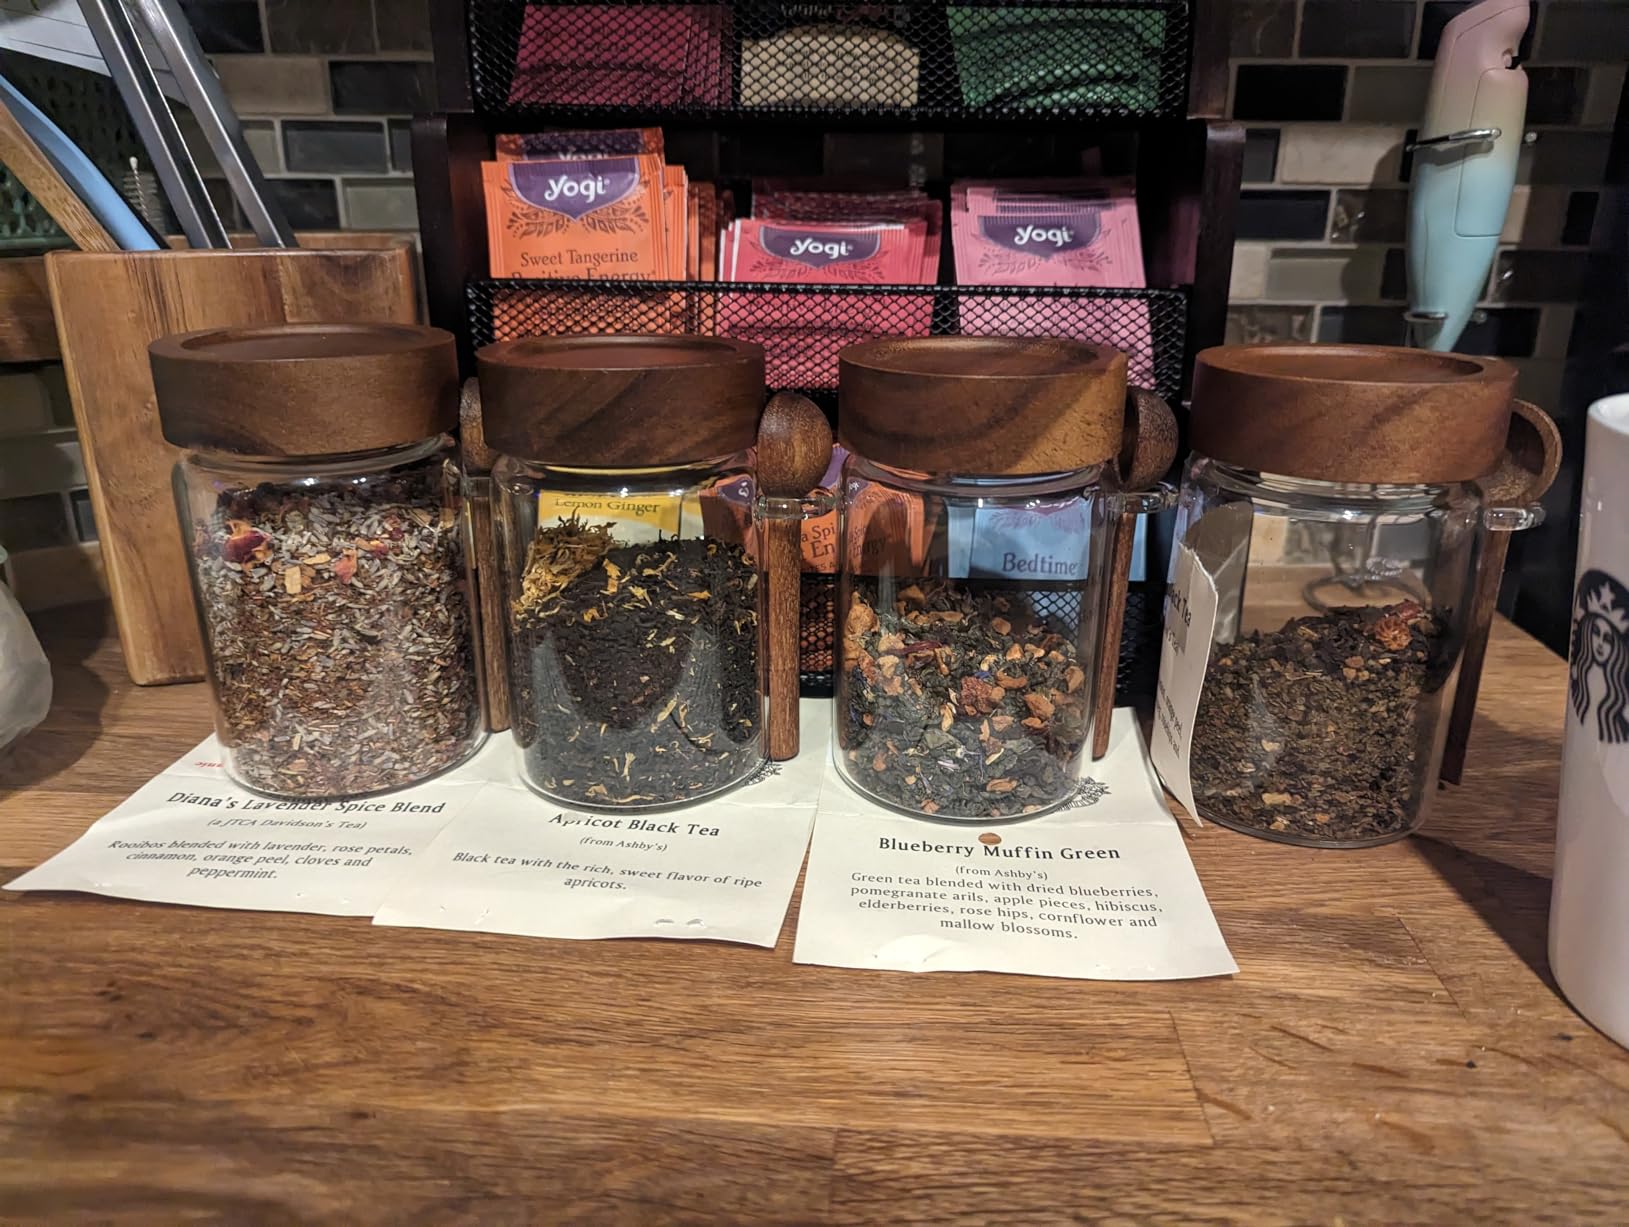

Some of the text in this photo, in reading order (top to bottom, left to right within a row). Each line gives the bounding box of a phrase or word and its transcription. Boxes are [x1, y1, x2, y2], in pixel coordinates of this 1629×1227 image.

[520, 248, 638, 267] Sweet Tangerine
[554, 498, 661, 516] Lemon Ginger
[1002, 551, 1077, 576] Bedtime
[166, 792, 446, 814] Diana's Lavender Spice Blend
[260, 819, 335, 828] Davidson's
[338, 821, 367, 830] Tea)
[548, 813, 720, 836] Aicot Black Tea
[108, 840, 413, 855] Rooibos blended with lavender, rose petals,
[579, 836, 668, 852] (from Ashby's)
[879, 837, 1121, 860] Blueberry Muffin Green
[126, 852, 374, 867] cinnamon, orange peel, cloves and
[186, 867, 278, 879] peppermint.
[452, 852, 763, 888] Black tea with the rich, sweet flavor of ripe
[955, 866, 1048, 881] (from Ashby's)
[563, 877, 627, 890] apricots.
[851, 872, 1159, 898] Green tea blended with dried blueberries,
[851, 887, 1163, 912] pomegranate arils, apple pieces, hibiscus,
[859, 899, 1158, 927] elderberries, rose hips, cornflower and
[940, 919, 1078, 939] mallow blossoms.
